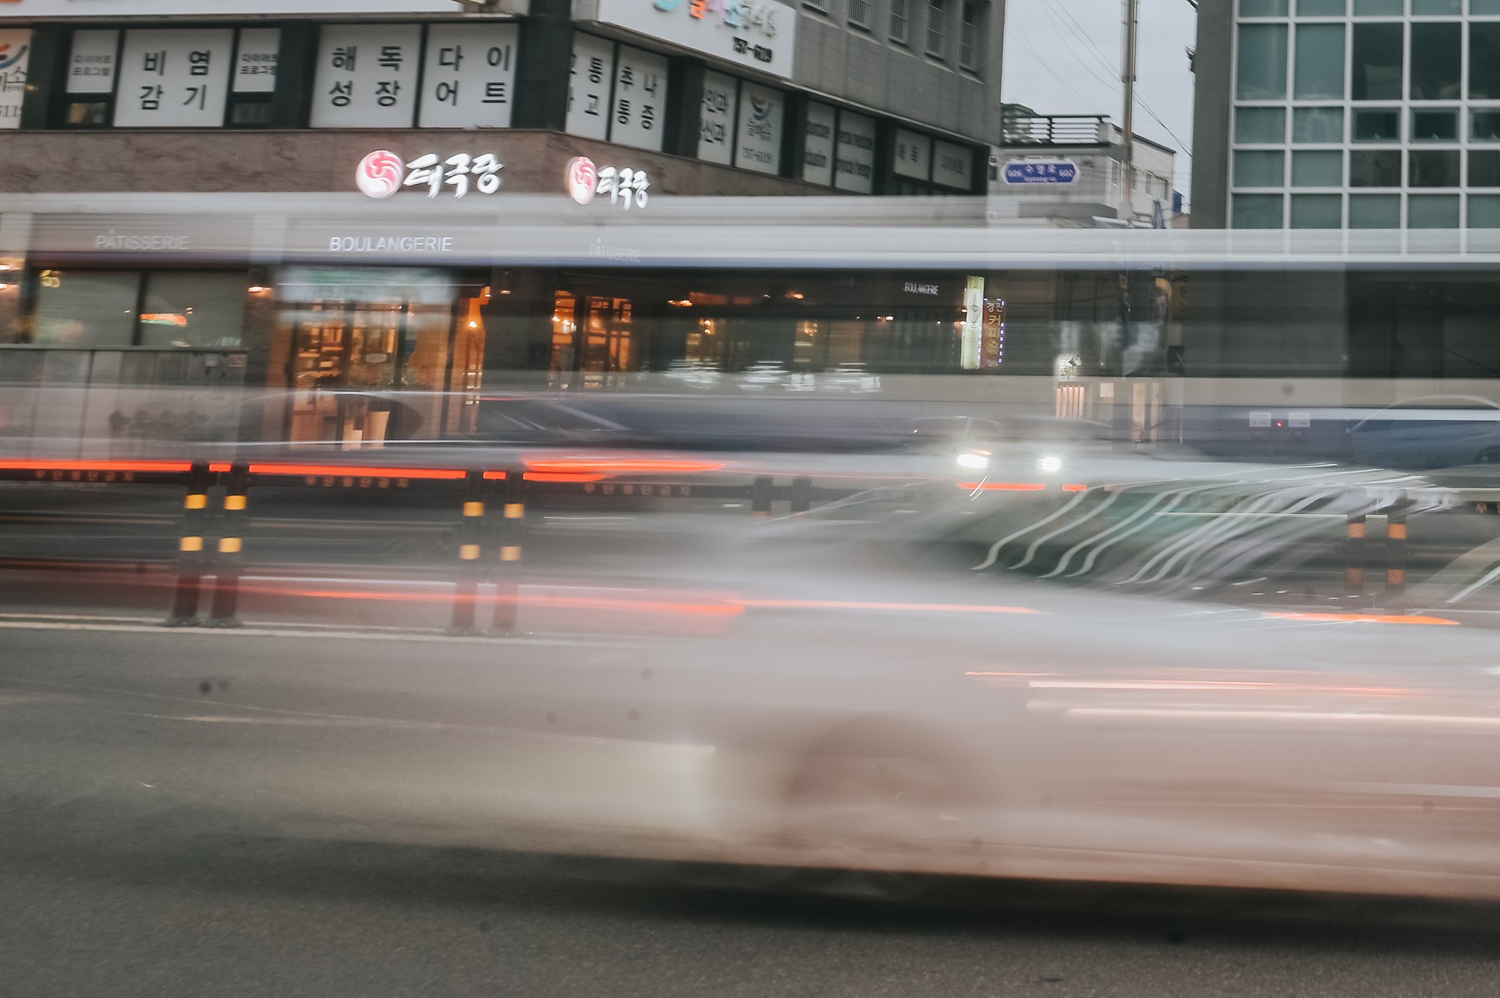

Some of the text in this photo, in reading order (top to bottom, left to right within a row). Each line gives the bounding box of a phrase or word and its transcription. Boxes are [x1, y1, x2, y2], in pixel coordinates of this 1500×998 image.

[143, 50, 211, 76] 비염
[332, 45, 403, 73] 해독
[439, 44, 512, 73] 다이
[329, 80, 401, 107] 성장
[435, 81, 508, 107] 어트
[620, 66, 658, 98] 추나
[140, 84, 207, 110] 감기
[617, 99, 655, 129] 통증
[330, 236, 453, 252] BOULANGERIE
